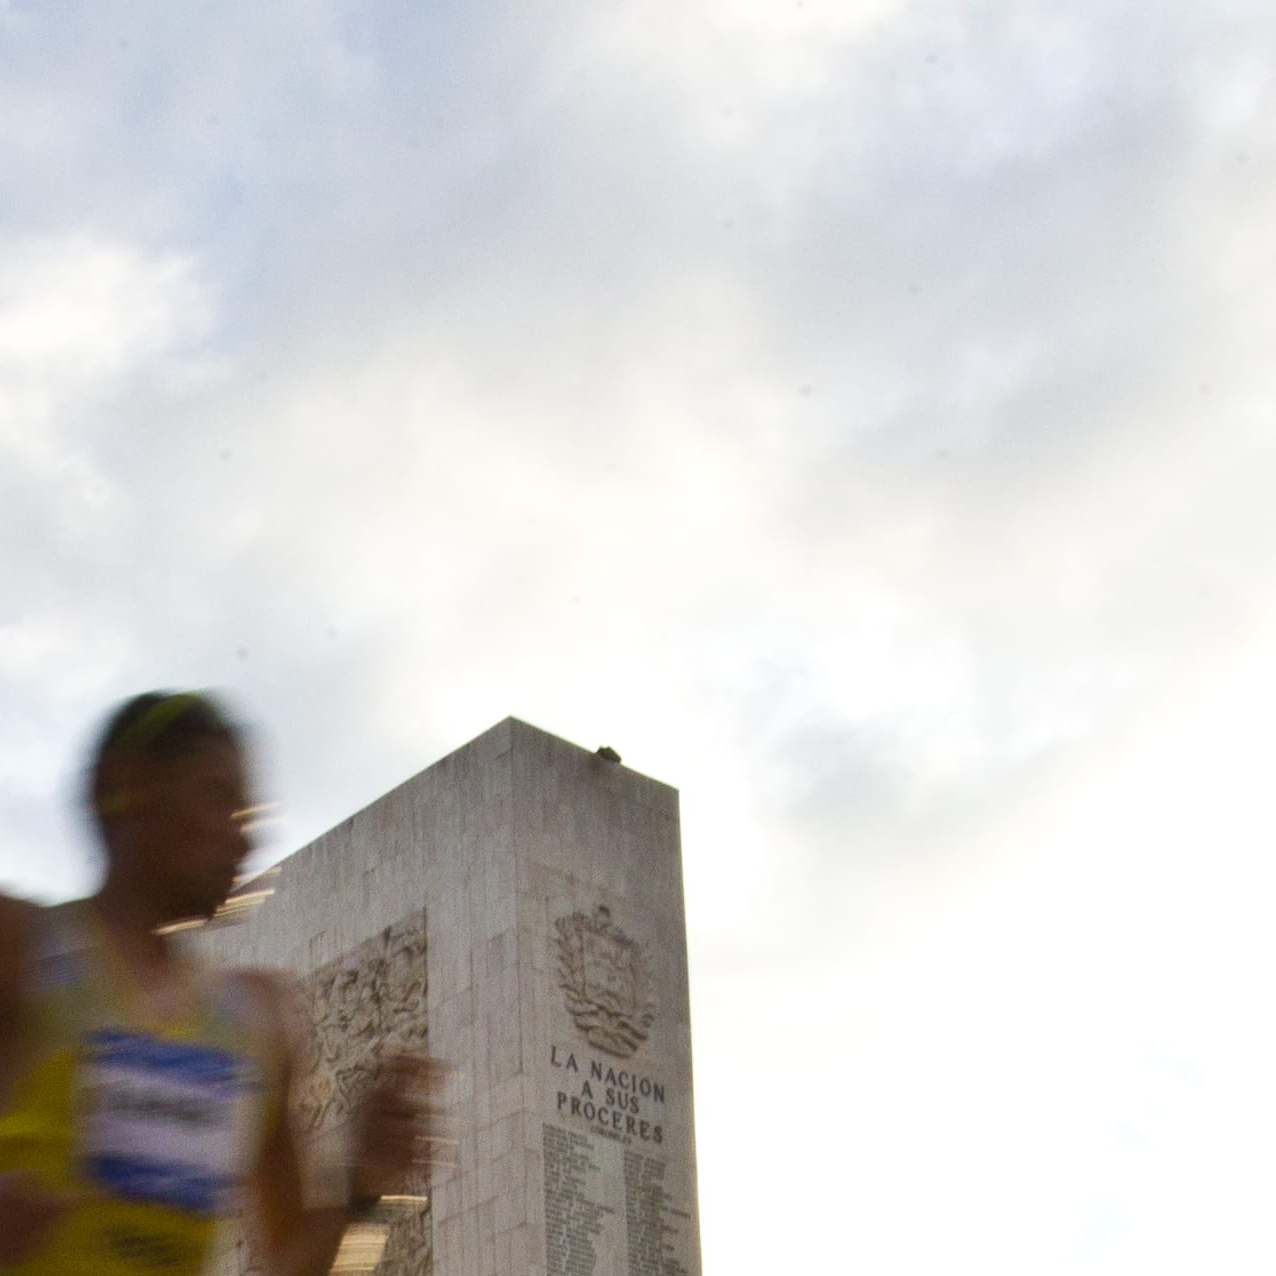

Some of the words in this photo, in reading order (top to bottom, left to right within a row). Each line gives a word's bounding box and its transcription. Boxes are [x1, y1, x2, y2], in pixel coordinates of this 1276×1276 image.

[550, 1045, 579, 1073] LA
[590, 1060, 667, 1104] NACION
[581, 1080, 594, 1099] A
[605, 1087, 640, 1115] SUS
[557, 1091, 664, 1144] PROCERES
